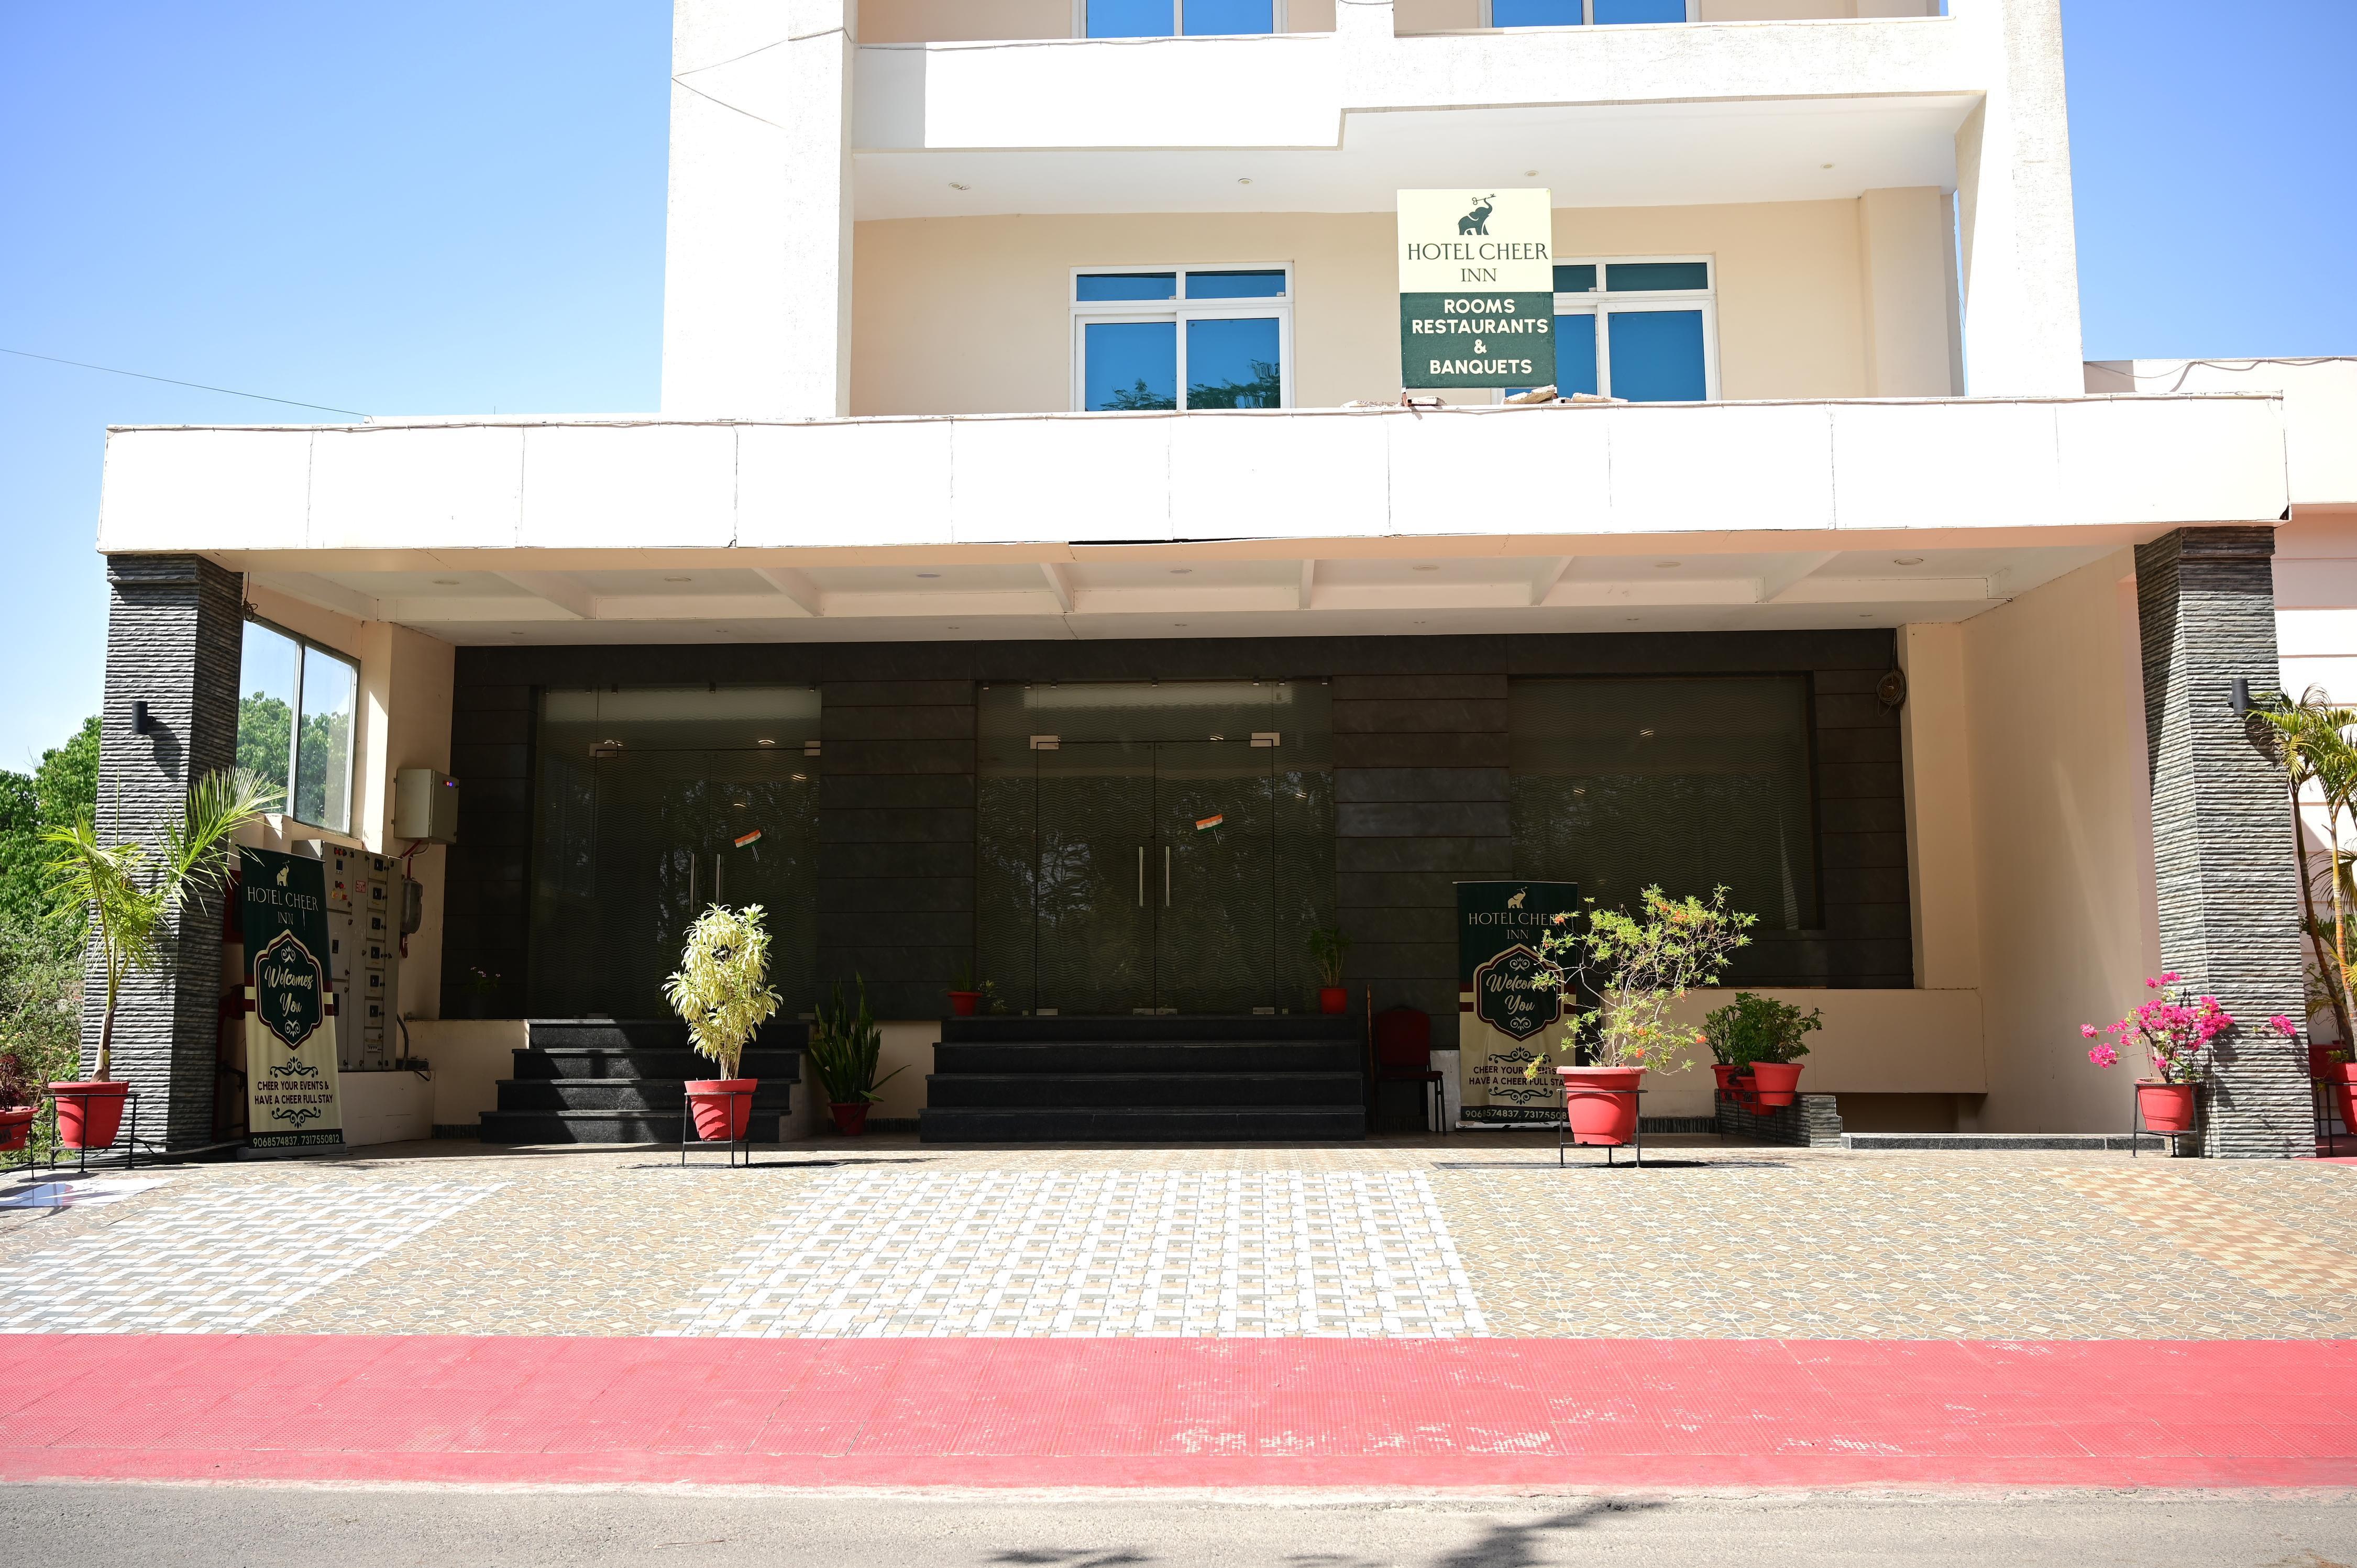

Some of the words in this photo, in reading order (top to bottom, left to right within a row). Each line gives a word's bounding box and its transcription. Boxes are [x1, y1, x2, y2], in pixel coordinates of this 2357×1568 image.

[1408, 243, 1474, 260] HOTEL
[1479, 243, 1548, 260] CHEER
[1460, 268, 1497, 282] INN
[1444, 299, 1515, 314] ROOMS
[1412, 318, 1548, 334] RESTAURANTS
[1473, 339, 1487, 354] &
[1430, 359, 1532, 374] BANQUETS
[248, 886, 282, 906] HOTEL
[285, 892, 318, 912] CHEER
[278, 911, 293, 925] INN
[1469, 912, 1515, 925] HOTEL
[1518, 913, 1561, 926] CHEE
[1506, 929, 1528, 939] INN
[264, 965, 313, 990] Welcomes
[1486, 973, 1548, 992] Welcos
[279, 992, 302, 1017] You
[1504, 995, 1535, 1015] You
[1526, 1066, 1557, 1075] ENTS
[257, 1081, 279, 1090] CHEER
[281, 1081, 299, 1090] YOUR
[300, 1081, 323, 1090] EVENTS
[324, 1081, 329, 1090] &
[255, 1095, 273, 1105] HAVE
[274, 1095, 280, 1105] A
[281, 1095, 302, 1104] CHEER
[303, 1095, 317, 1103] FULL
[318, 1094, 333, 1103] STAY
[1524, 1110, 1568, 1120] 73175508
[301, 1133, 339, 1145] 7317550812
